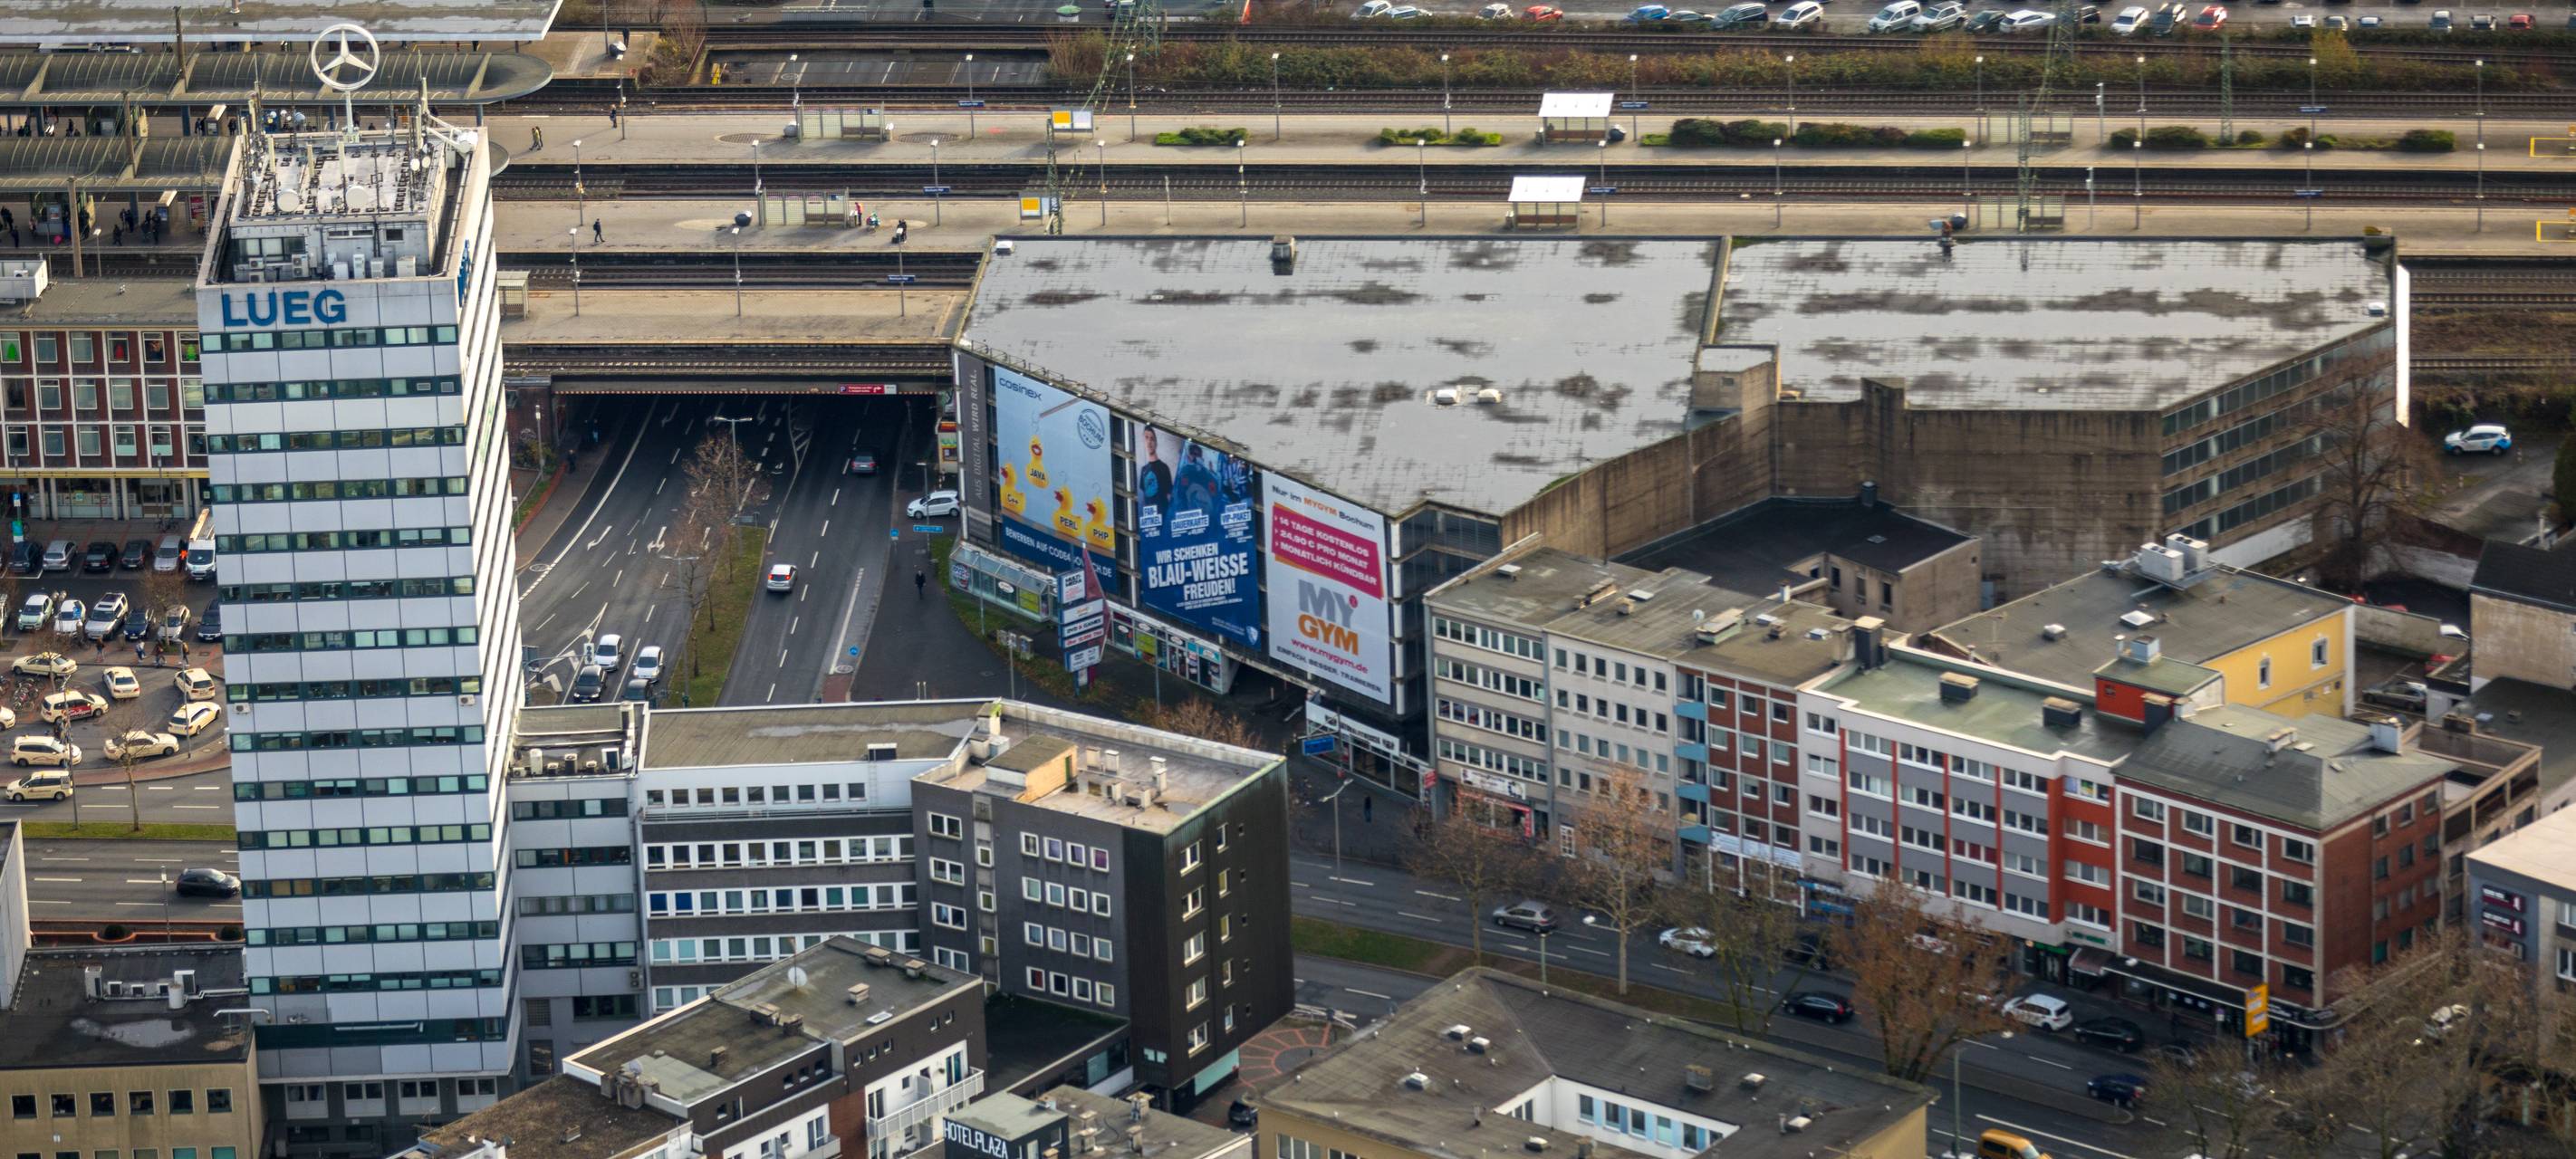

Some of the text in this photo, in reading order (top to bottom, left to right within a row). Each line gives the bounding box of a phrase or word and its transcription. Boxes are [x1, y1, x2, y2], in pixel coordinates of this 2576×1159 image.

[223, 290, 347, 327] LUEG
[999, 378, 1042, 401] cosinex
[970, 369, 984, 499] AUS DIGITAL WIRD REAL.
[1078, 415, 1105, 444] BOCHUM
[1030, 469, 1045, 480] JAVA
[1060, 516, 1078, 531] PERL
[1290, 492, 1302, 503] im
[1304, 497, 1338, 516] MYGYM
[1339, 511, 1375, 531] Bochum
[1005, 527, 1034, 548] BEWERBEN
[1036, 541, 1048, 554] AUF
[1093, 529, 1109, 540] PHP
[1291, 521, 1315, 536] TAGE
[1316, 530, 1370, 558] KOSTENLOS
[1156, 542, 1218, 564] WIR SCHENKEN
[1281, 541, 1377, 585] MONATLICH KÜNDBAR
[1317, 543, 1337, 556] PRO
[1338, 551, 1369, 569] MONAT
[1148, 552, 1248, 589] BLAU-WEISSE
[1183, 578, 1235, 600] FREUDEN!
[1298, 580, 1354, 628] MY
[1298, 614, 1359, 656] GYM
[1291, 639, 1368, 674] www.mygym.de
